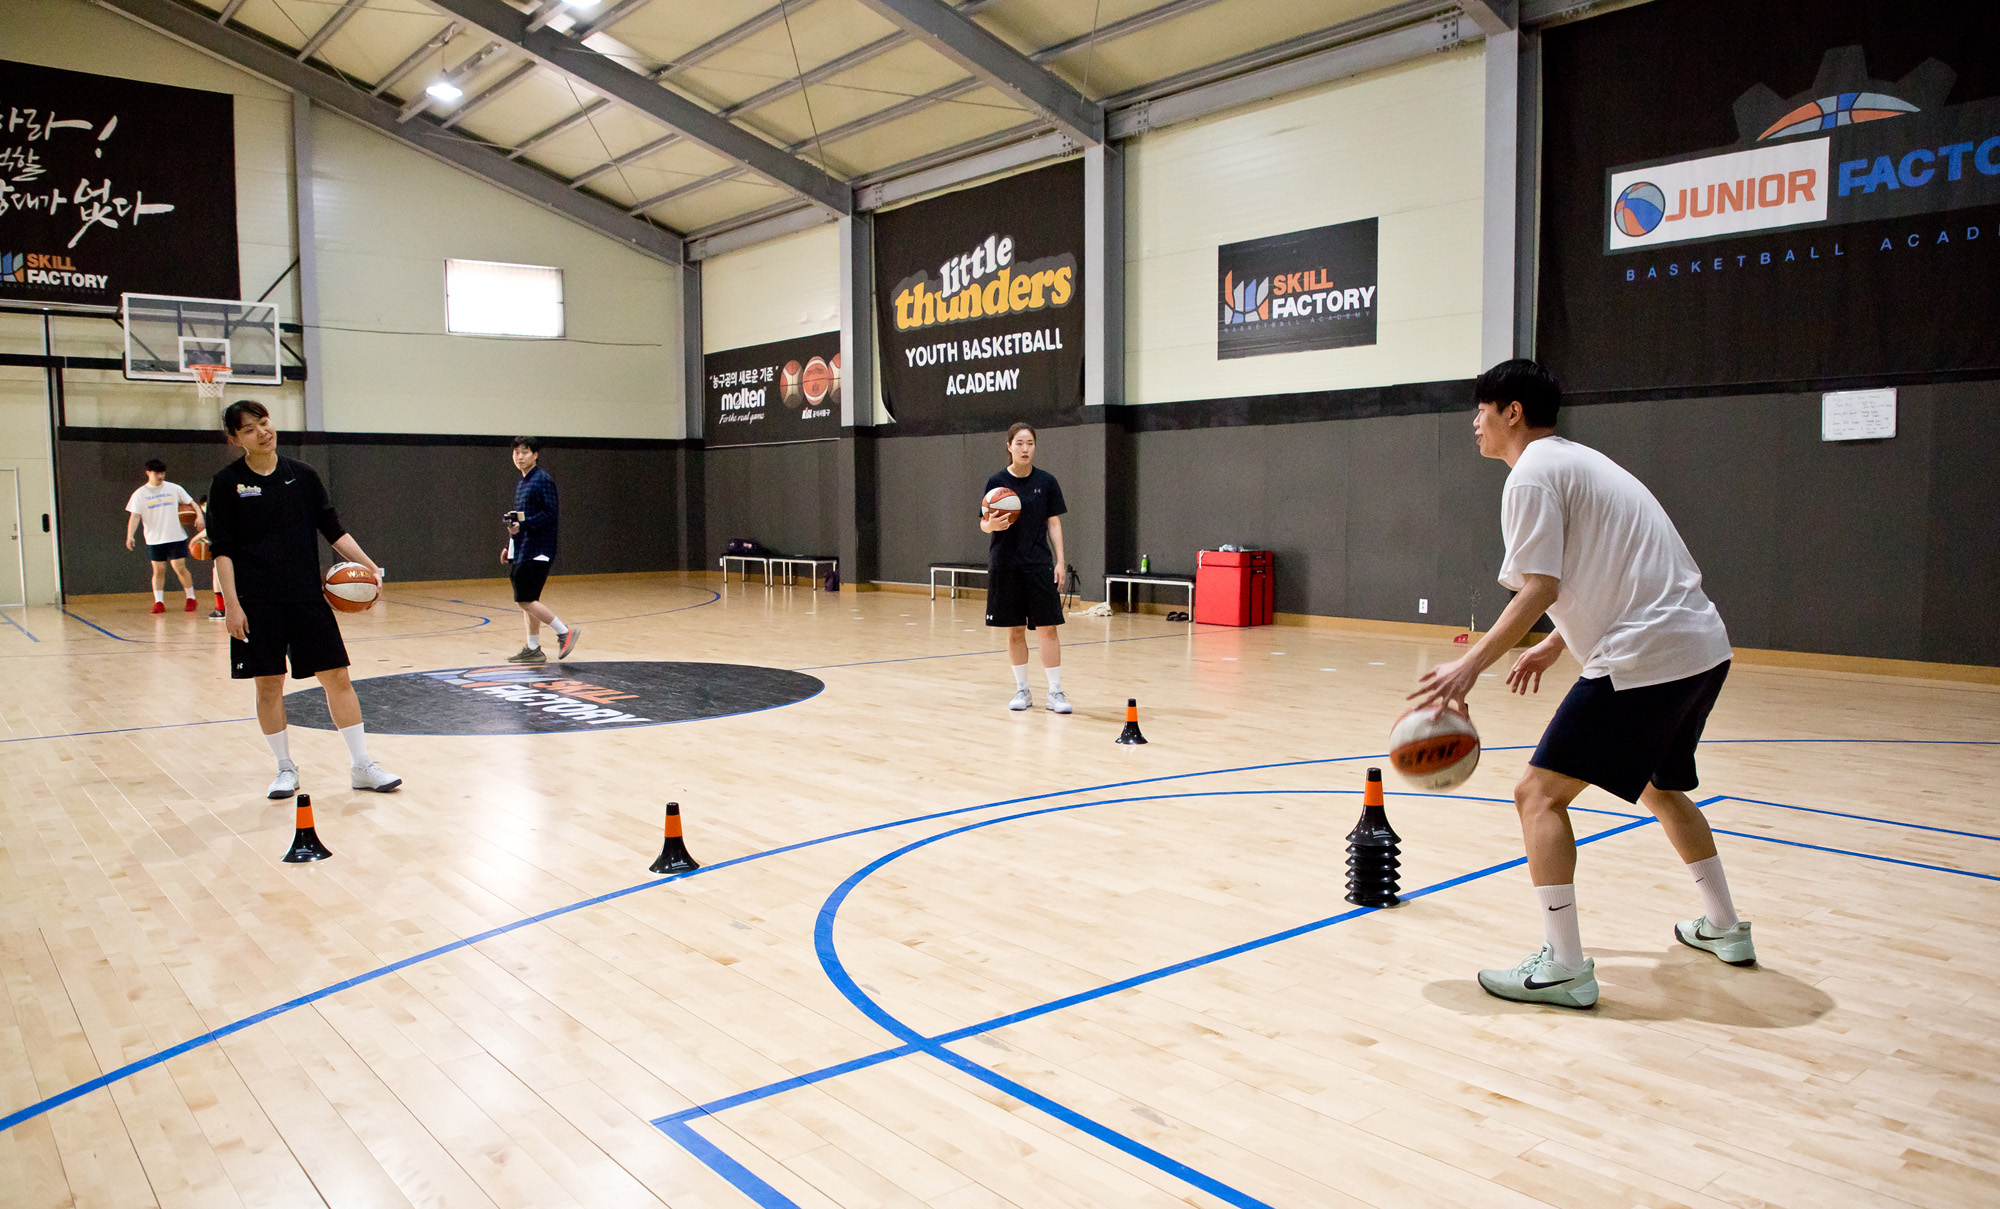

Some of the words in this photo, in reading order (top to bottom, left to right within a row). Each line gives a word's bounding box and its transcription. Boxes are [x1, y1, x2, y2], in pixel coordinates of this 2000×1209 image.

[1665, 168, 1816, 222] JUNIOR
[67, 178, 175, 249] 없다
[27, 253, 76, 271] SKILL
[940, 235, 1012, 298] little
[1626, 243, 1844, 282] BASKETBALL
[27, 269, 108, 289] FACTORY
[1273, 268, 1334, 296] SKILL
[895, 266, 1071, 329] thunders
[1272, 285, 1376, 319] FACTORY
[1224, 319, 1300, 334] BASKETBALL
[1310, 311, 1371, 324] ACADEMY
[905, 341, 958, 368] YOUTH
[963, 328, 1063, 361] BASKETBALL
[738, 368, 758, 386] 새로운
[946, 368, 1020, 396] ACADEMY
[721, 388, 765, 411] molten
[472, 684, 653, 725] FACTORY
[532, 680, 640, 704] SKILL
